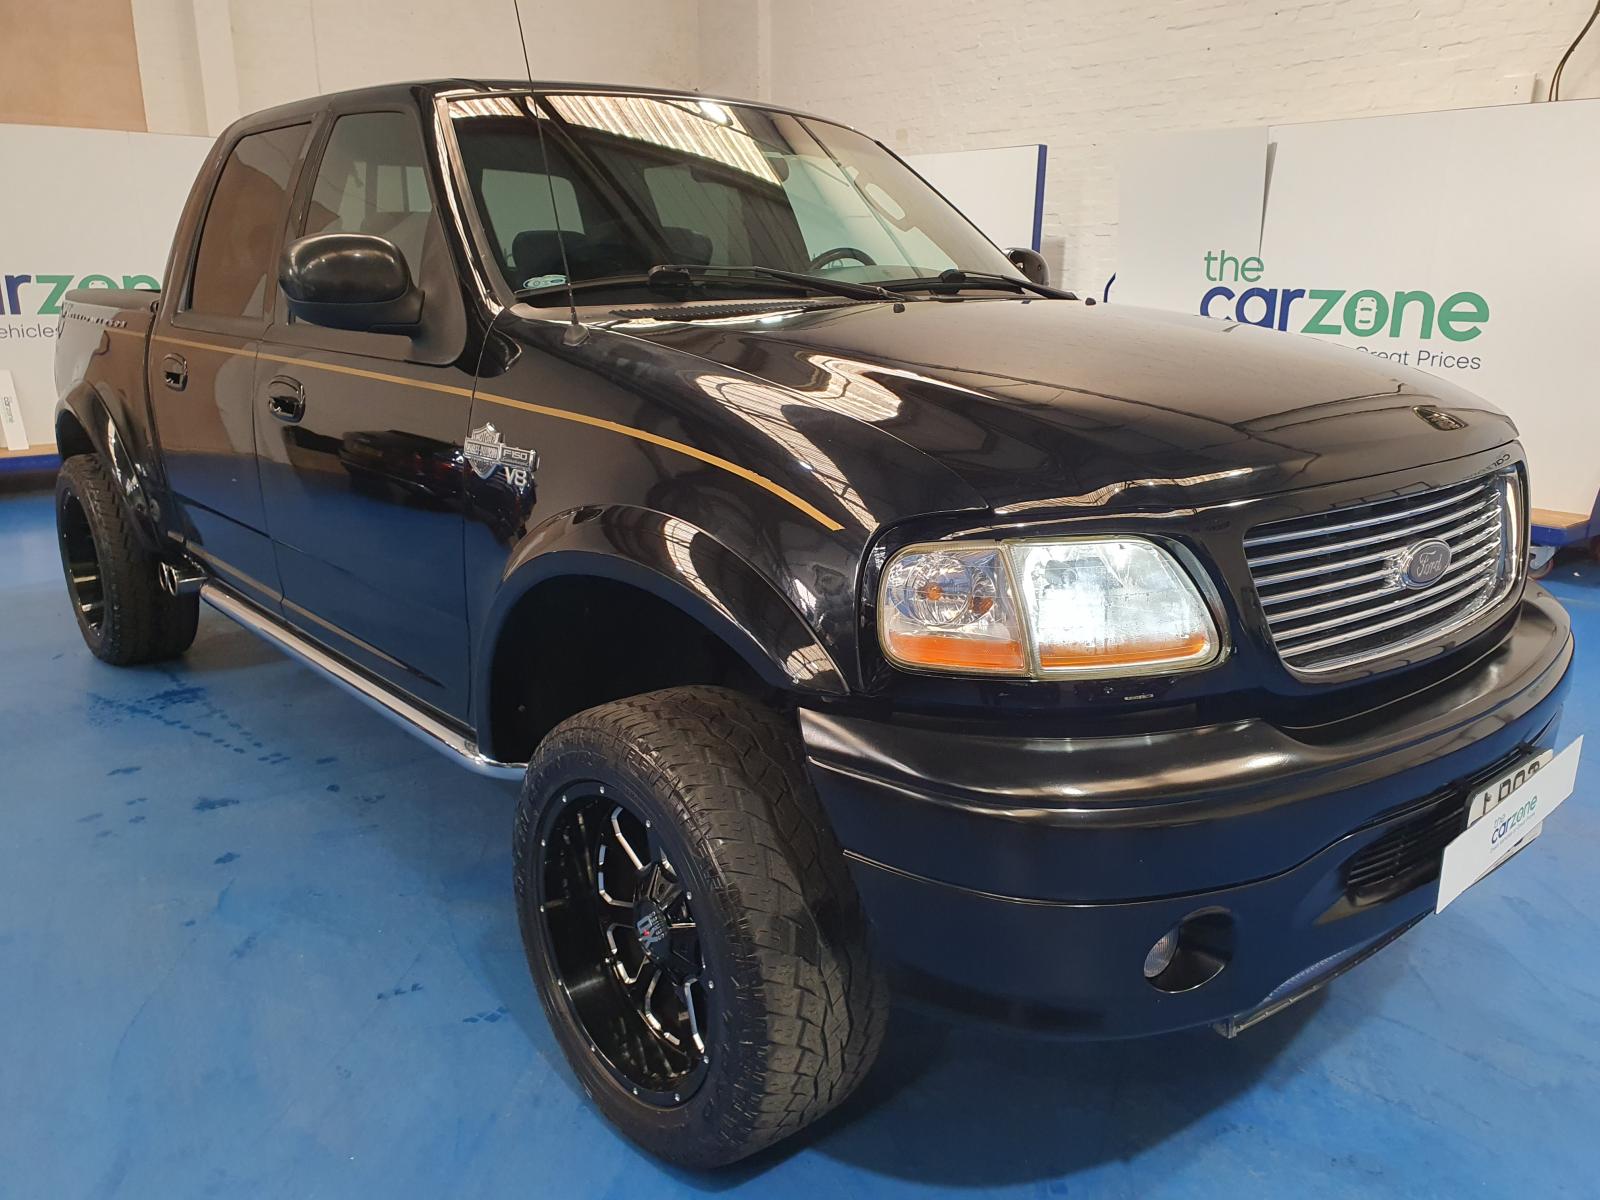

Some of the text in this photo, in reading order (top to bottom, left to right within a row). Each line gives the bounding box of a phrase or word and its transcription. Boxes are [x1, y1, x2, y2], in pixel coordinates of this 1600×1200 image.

[1204, 250, 1265, 282] the
[1199, 286, 1490, 341] carzone
[0, 323, 58, 339] ehicle
[1417, 350, 1481, 370] Prices
[505, 466, 527, 485] V8
[1416, 550, 1443, 577] Ford
[1491, 795, 1538, 844] carzone
